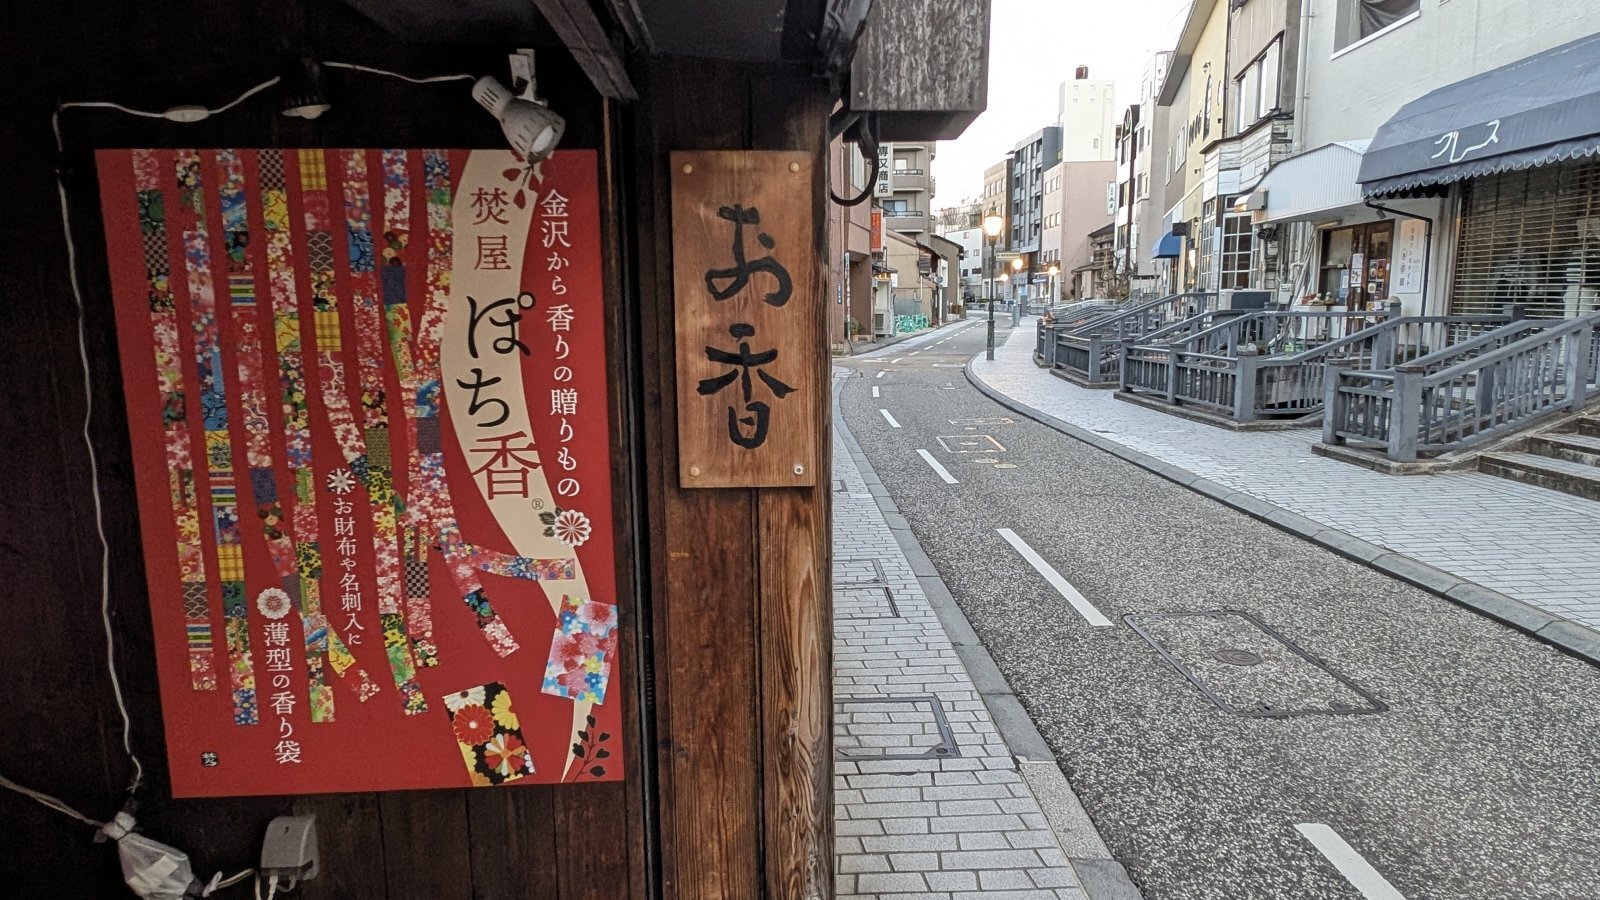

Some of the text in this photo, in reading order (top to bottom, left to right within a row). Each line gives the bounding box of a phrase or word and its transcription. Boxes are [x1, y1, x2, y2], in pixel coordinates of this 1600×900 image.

[470, 187, 512, 271] 焚屋
[456, 291, 542, 501] ぽち香
[540, 188, 580, 498] 金沢から香りの贈りもの
[697, 203, 799, 450] お香
[331, 497, 365, 646] お財布や名刺入に
[262, 622, 302, 765] 薄型の香り袋
